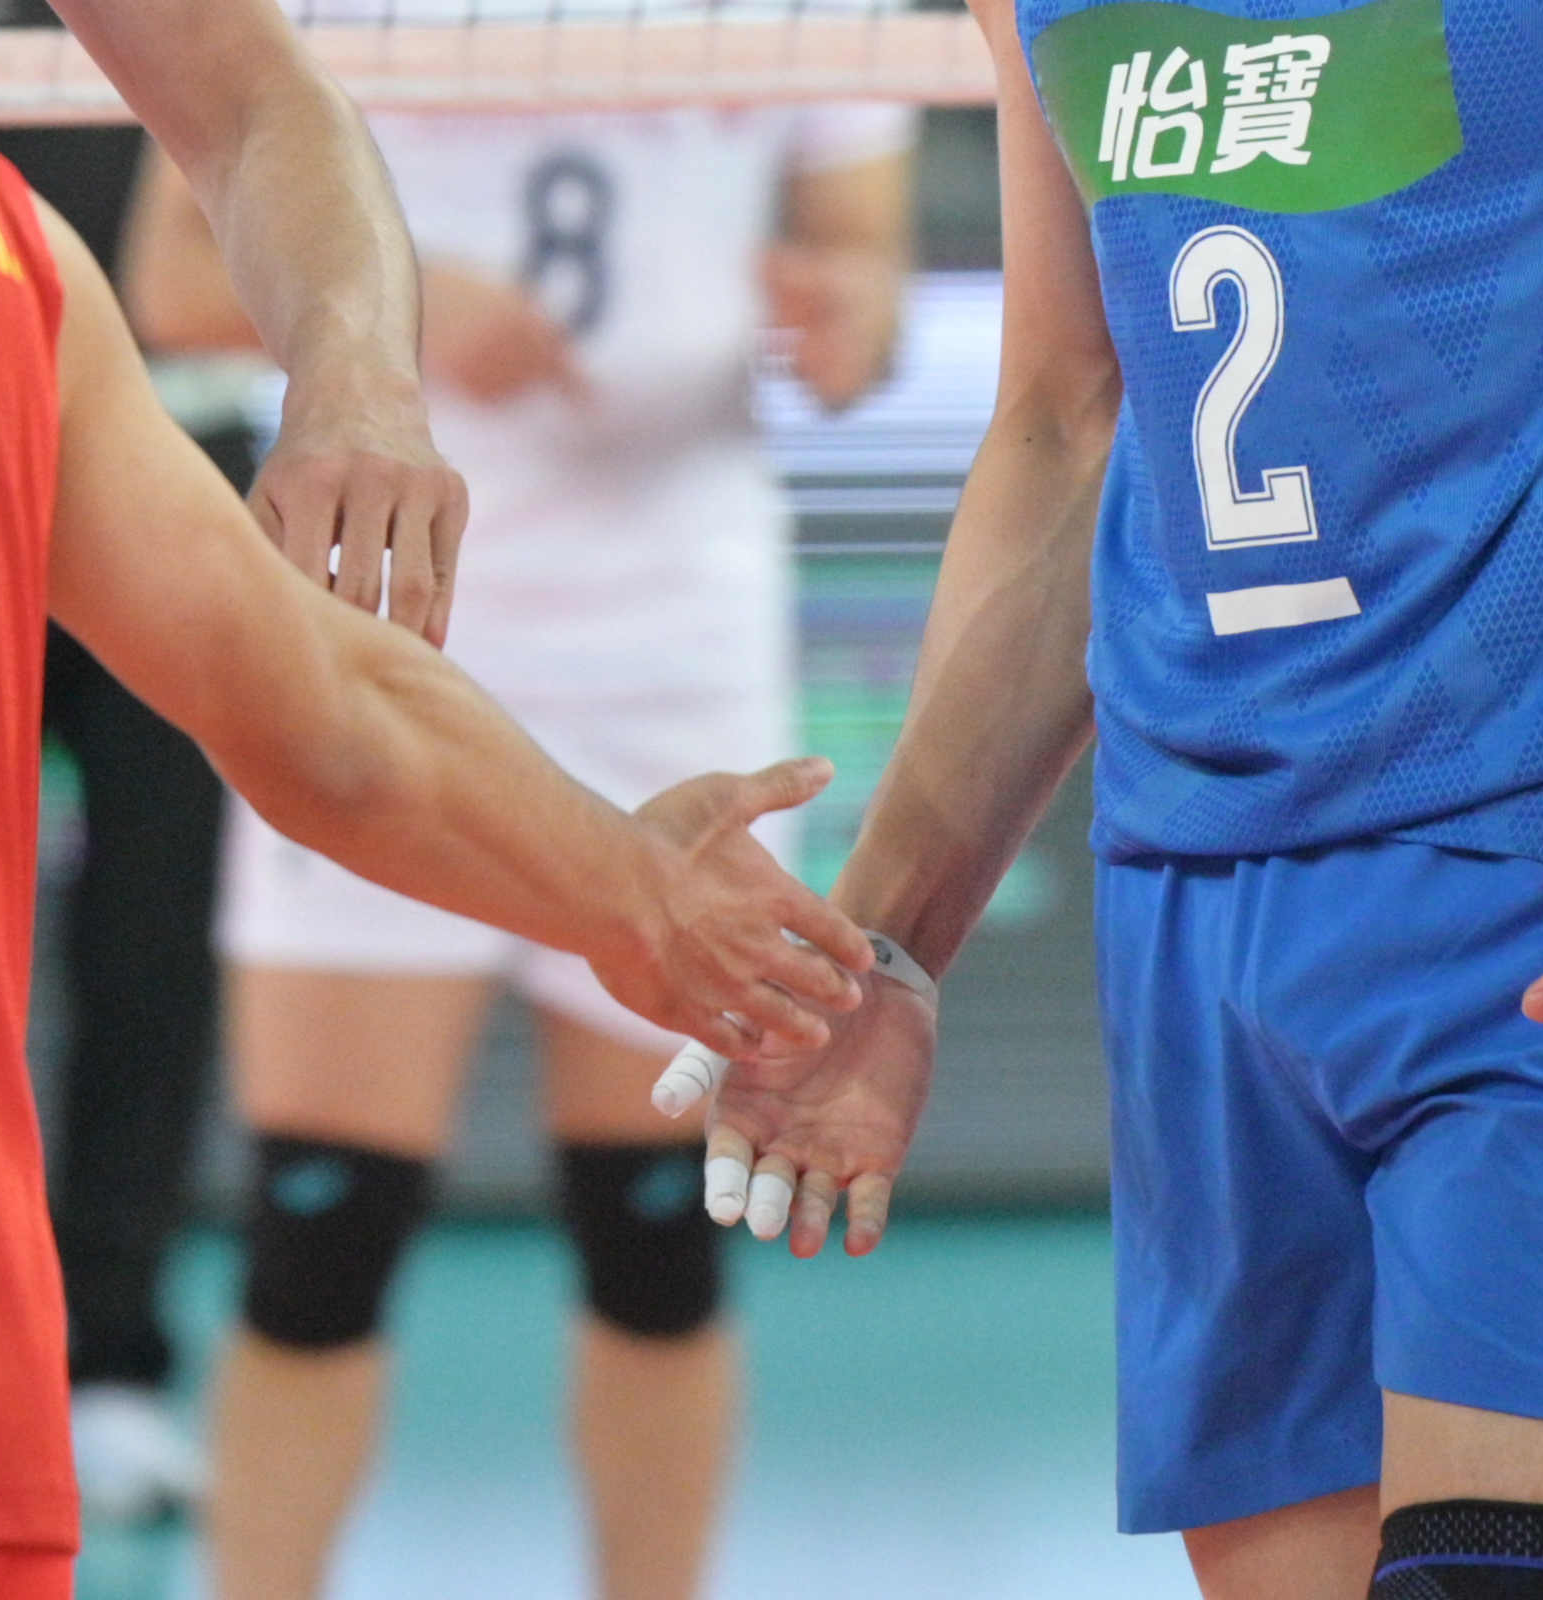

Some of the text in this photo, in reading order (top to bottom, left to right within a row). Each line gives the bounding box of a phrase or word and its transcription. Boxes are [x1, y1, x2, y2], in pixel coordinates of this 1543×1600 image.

[1098, 34, 1331, 182] 怡寶
[519, 144, 618, 340] 8
[1169, 224, 1318, 551] 2
